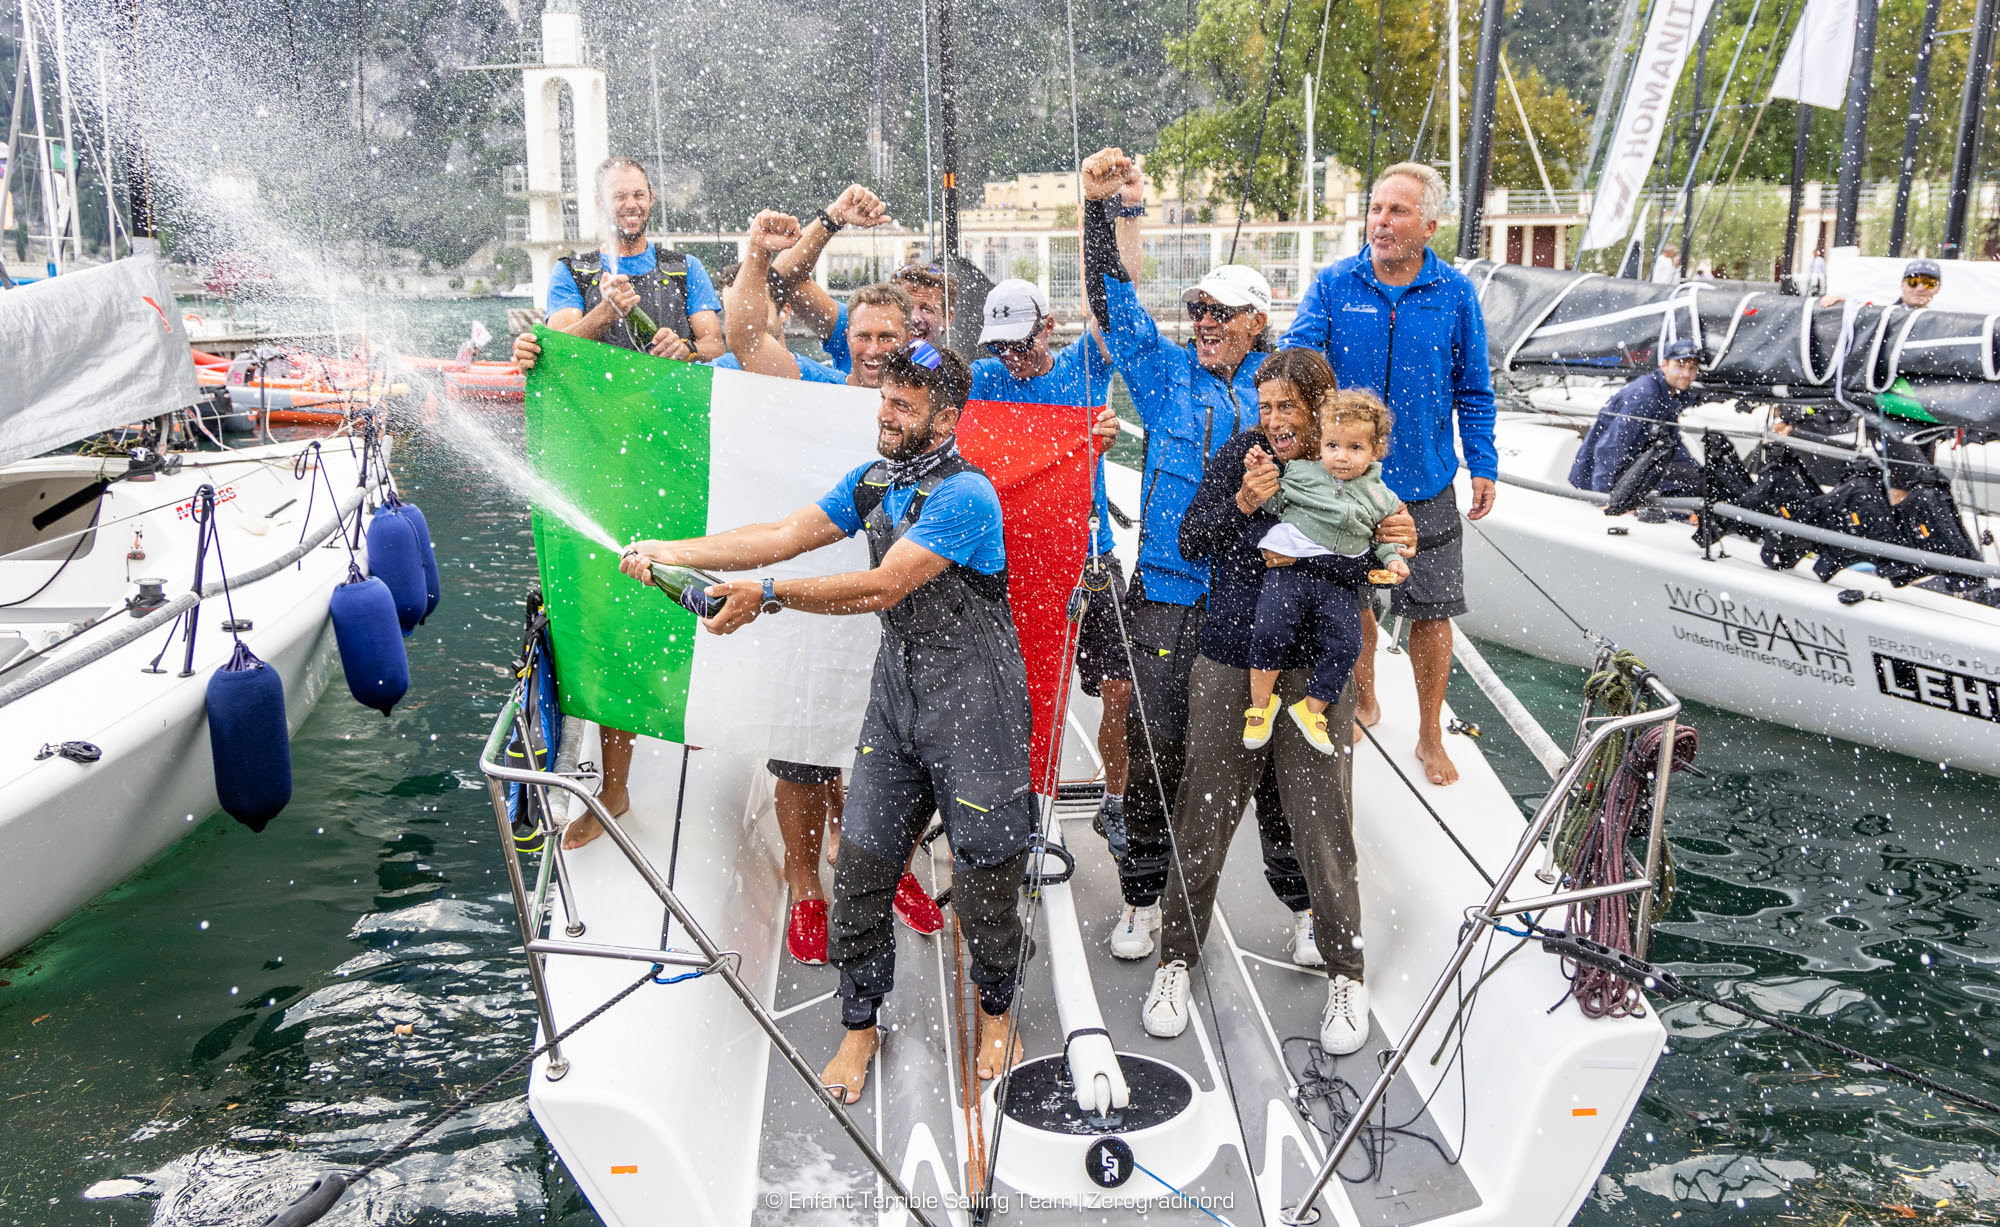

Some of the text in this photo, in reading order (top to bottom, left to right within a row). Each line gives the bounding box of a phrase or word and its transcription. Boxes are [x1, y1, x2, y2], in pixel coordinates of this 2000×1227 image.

[1621, 0, 1694, 160] HOMANIT
[232, 372, 243, 385] 5
[1672, 624, 1856, 687] Unternehmensgruppe
[1867, 635, 1954, 667] BERATUNG
[1880, 657, 2000, 720] LEH
